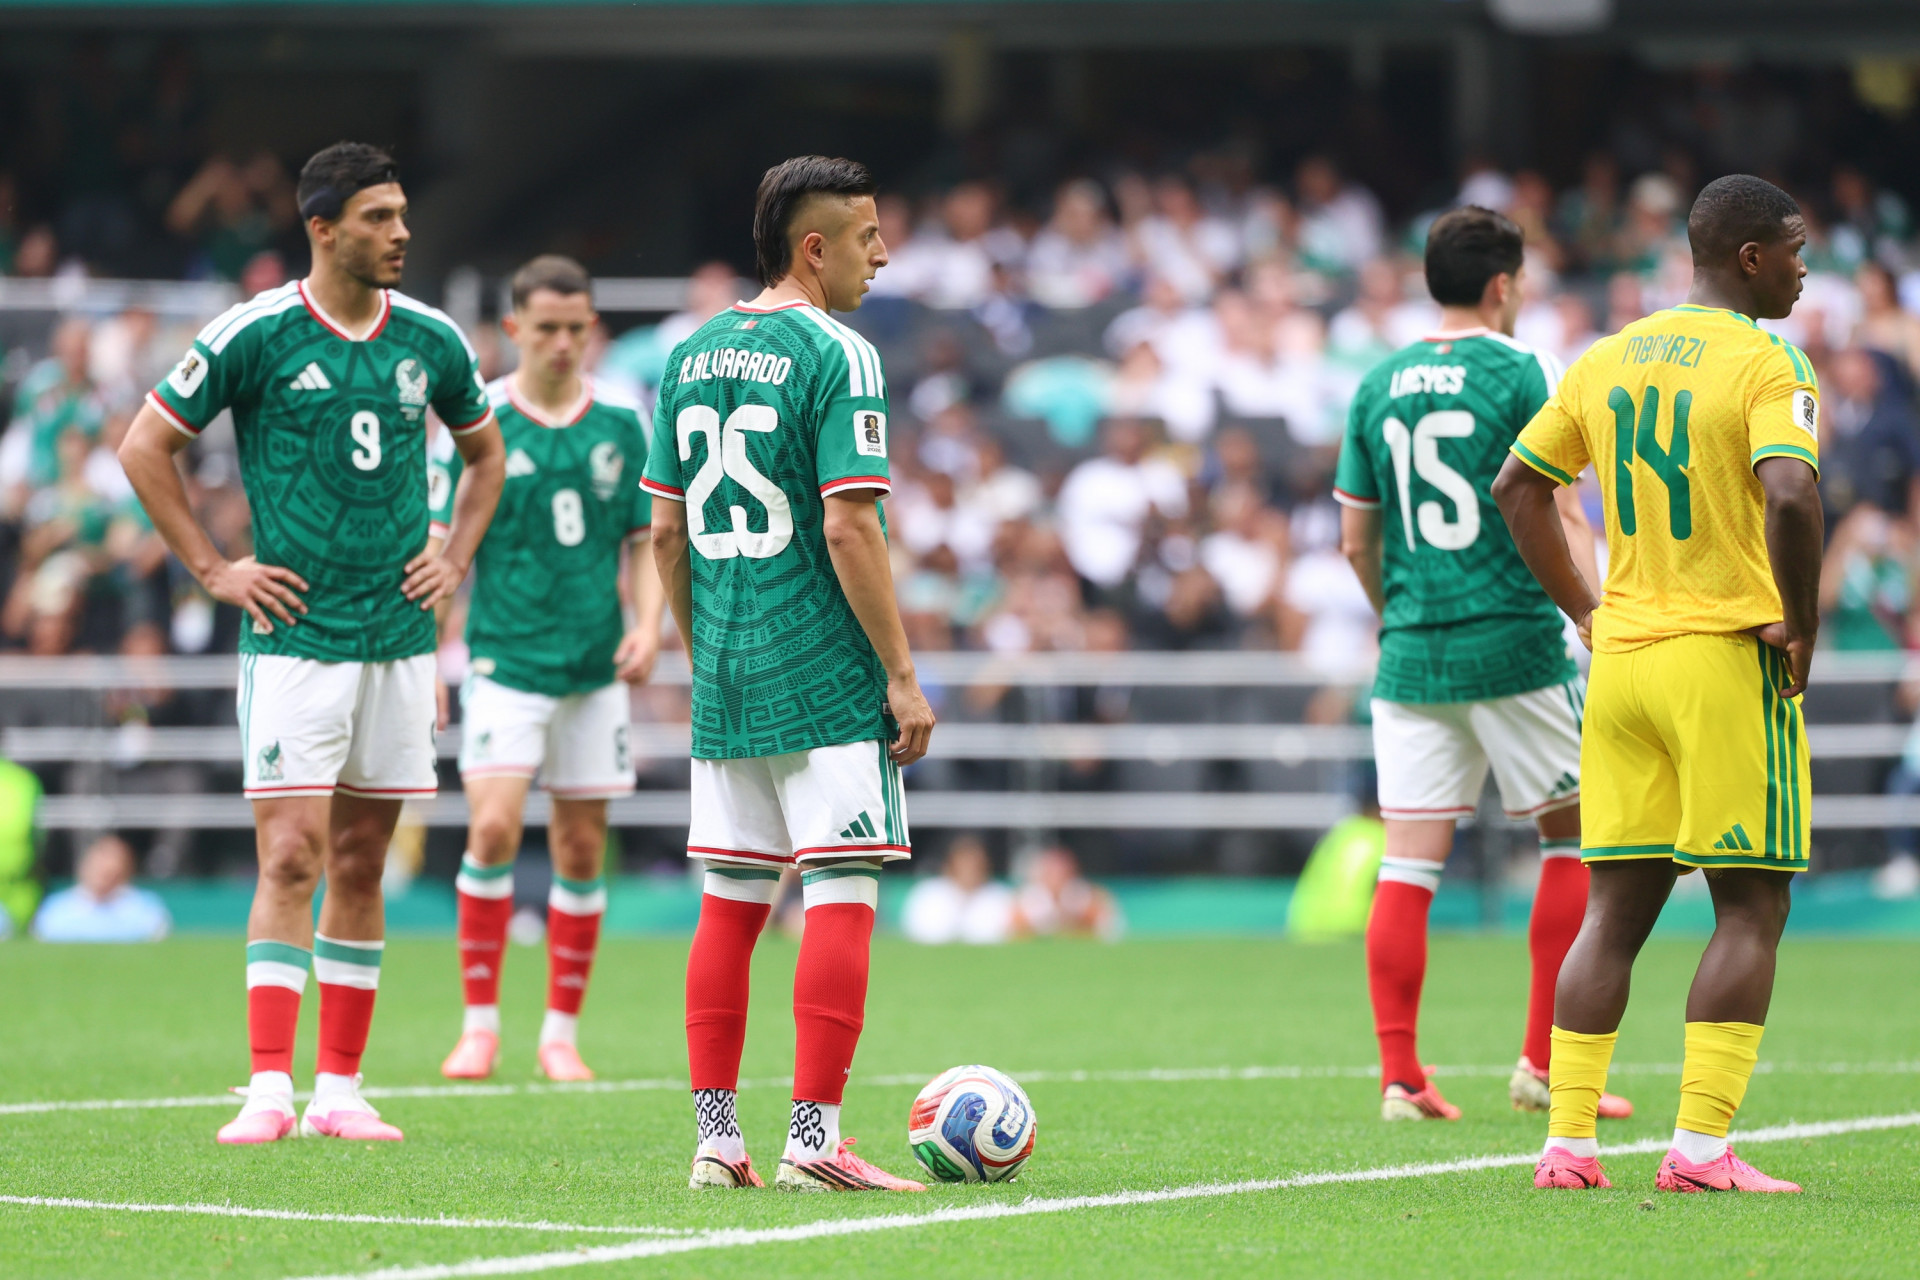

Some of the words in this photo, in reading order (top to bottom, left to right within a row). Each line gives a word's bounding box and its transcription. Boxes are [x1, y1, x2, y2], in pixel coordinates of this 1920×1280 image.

[678, 347, 793, 386] R.ALVARADO
[1621, 333, 1707, 369] MBOKAZI
[350, 410, 382, 471] 9
[1607, 385, 1693, 541] 14
[676, 404, 794, 560] 25
[1382, 410, 1481, 553] 15
[551, 487, 586, 546] 8
